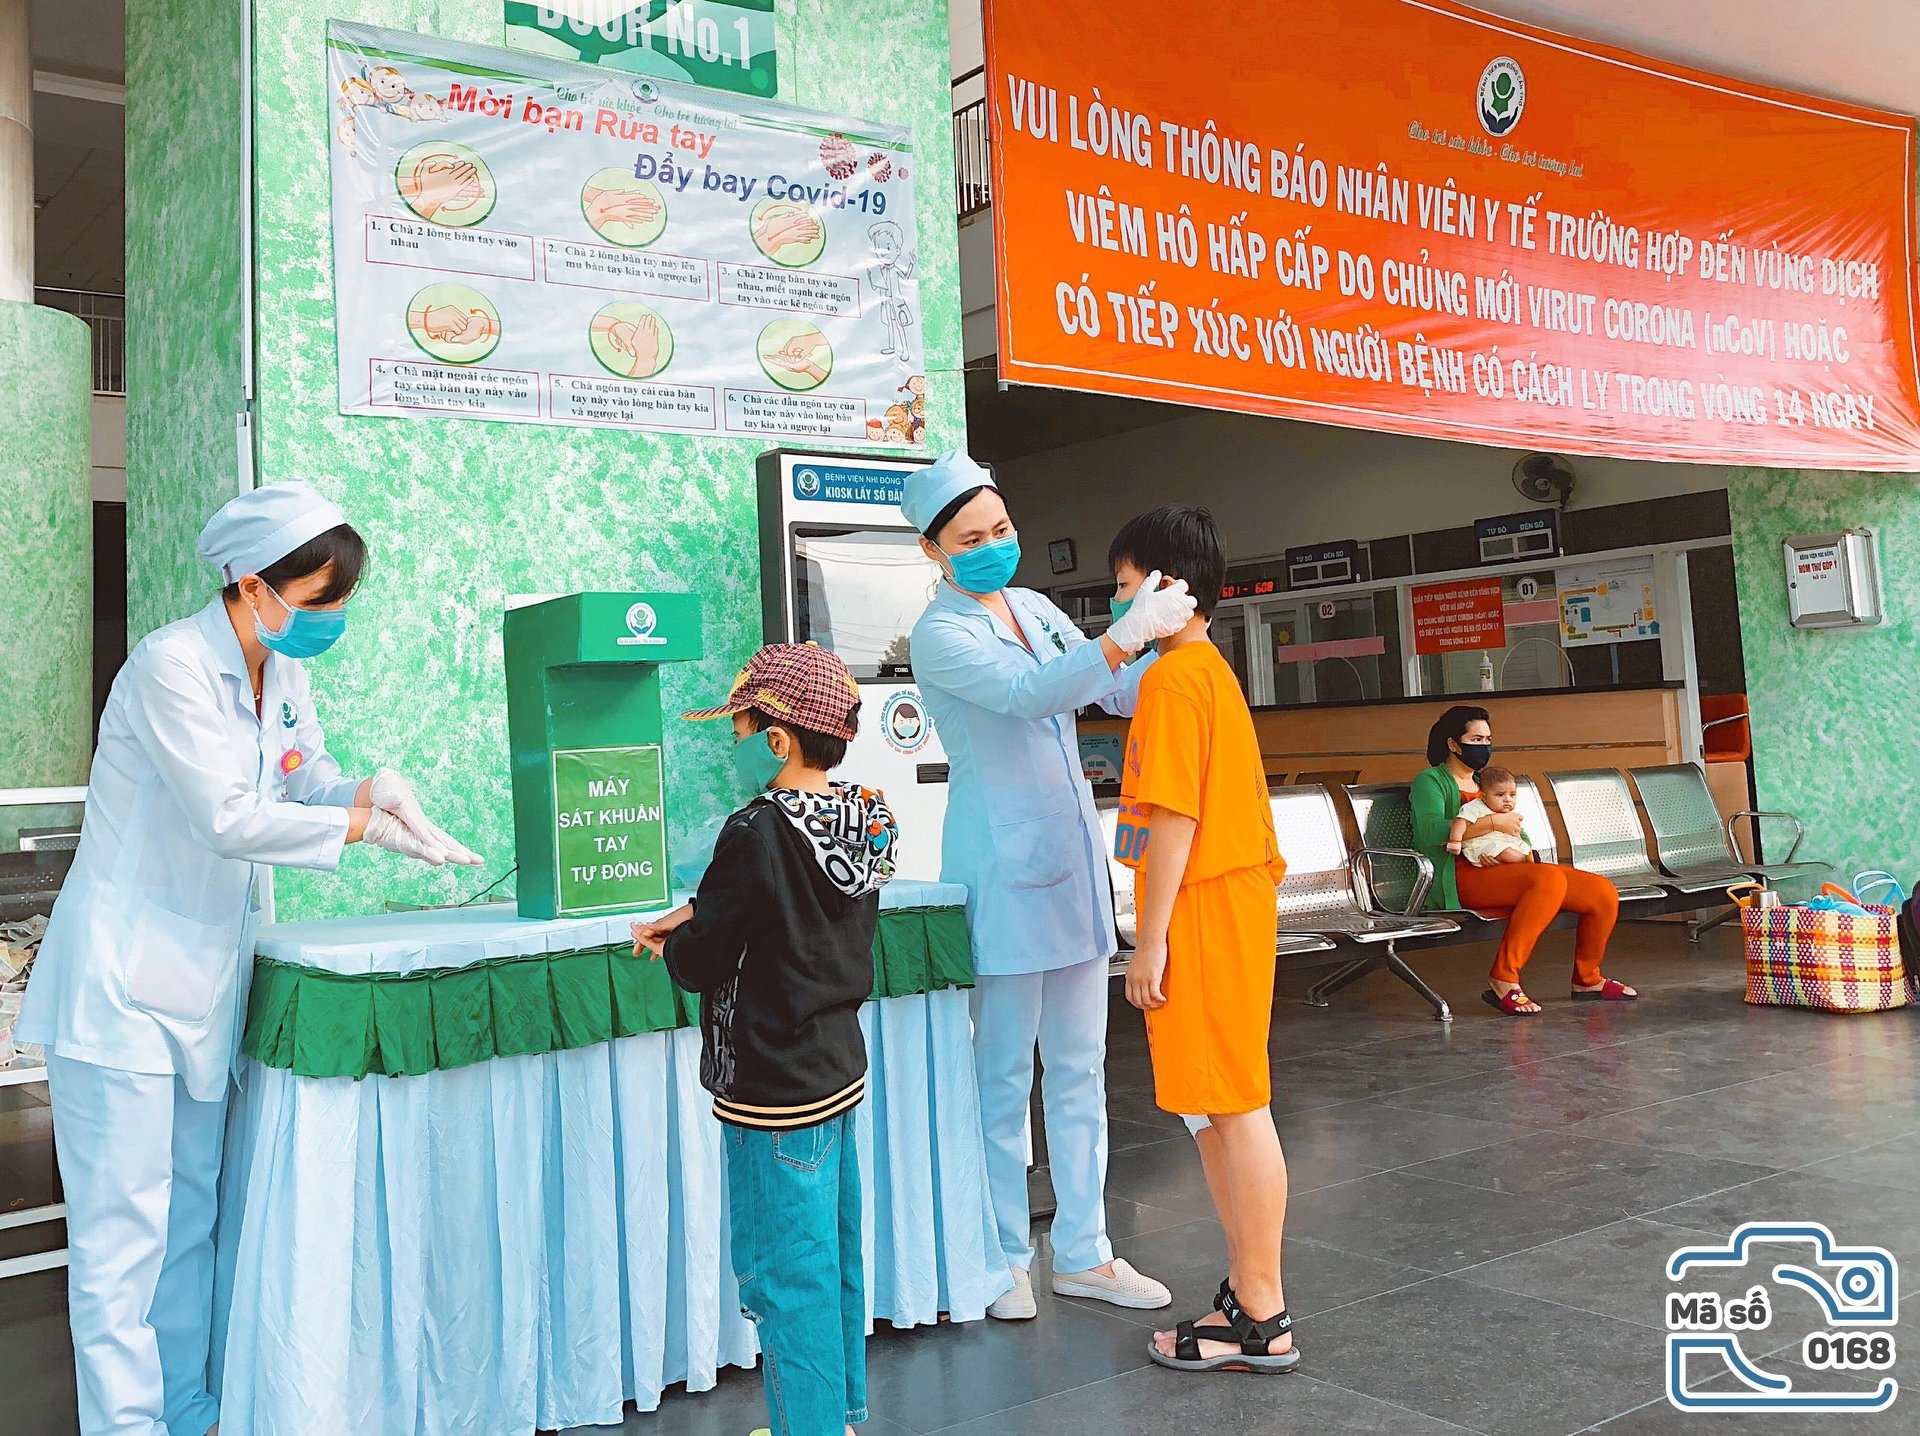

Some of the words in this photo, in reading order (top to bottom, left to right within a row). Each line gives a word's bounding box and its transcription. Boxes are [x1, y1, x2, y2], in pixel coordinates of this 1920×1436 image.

[666, 0, 750, 70] No.1
[448, 84, 512, 119] Mời
[522, 97, 583, 133] bạn
[595, 108, 658, 145] Rửa
[670, 123, 717, 161] tay
[634, 151, 694, 193] Đẩy
[702, 165, 756, 202] bay
[767, 174, 887, 215] Covid-19
[1008, 73, 1058, 142] VUI
[1070, 86, 1152, 169] LÒNG
[1160, 120, 1261, 194] THÔNG
[1270, 142, 1328, 208] BÁO
[1337, 162, 1409, 226] NHÂN
[1418, 178, 1476, 239] VIÊN
[1484, 198, 1500, 242] Y
[1508, 192, 1544, 250] TẾ
[1546, 209, 1638, 269] TRƯỜNG
[1646, 230, 1693, 282] HỢP
[1700, 230, 1746, 284] ĐẾN
[1753, 241, 1814, 294] VÙNG
[1822, 258, 1879, 306] DỊCH
[371, 221, 380, 231] 1.
[390, 222, 413, 235] Chà
[417, 227, 423, 236] 2
[427, 228, 450, 240] lòng
[455, 231, 474, 242] bàn
[478, 236, 494, 246] tay
[498, 238, 517, 248] vào
[391, 238, 419, 249] nhau
[549, 244, 557, 253] 2.
[590, 249, 595, 257] 2
[607, 266, 622, 275] tay
[626, 267, 640, 276] kia
[722, 268, 730, 276] 3.
[759, 271, 763, 279] 2
[766, 272, 785, 283] lòng
[823, 279, 837, 288] vào
[1066, 184, 1148, 257] VIÊM
[1156, 204, 1198, 267] HÔ
[1207, 211, 1266, 279] HẤP
[1275, 226, 1329, 291] CẤP
[1338, 250, 1374, 300] DO
[1382, 249, 1468, 317] CHỦNG
[1475, 269, 1520, 324] MỚI
[1528, 286, 1596, 335] VIRUT
[1604, 298, 1696, 348] CORONA
[1704, 312, 1774, 361] (nCoV)
[1784, 318, 1850, 372] HOẶC
[738, 282, 763, 292] nhau,
[815, 291, 828, 299] các
[831, 292, 850, 302] ngón
[738, 295, 751, 303] tay
[826, 304, 838, 313] tay
[1056, 273, 1100, 338] CÓ
[1107, 281, 1178, 348] TIẾP
[1187, 298, 1250, 361] XÚC
[1256, 309, 1307, 369] VỚI
[1310, 324, 1392, 382] NGƯỜI
[1397, 332, 1467, 398] BỆNH
[1472, 345, 1504, 399] CÓ
[1512, 351, 1573, 407] CÁCH
[1581, 369, 1608, 410] LY
[1616, 373, 1695, 420] TRONG
[1701, 374, 1768, 426] VÒNG
[1774, 389, 1804, 426] 14
[1811, 383, 1874, 430] NGÀY
[376, 366, 385, 374] 4.
[422, 369, 443, 380] mặt
[447, 371, 477, 381] ngoài
[395, 381, 412, 391] tay
[440, 383, 460, 393] bàn
[465, 386, 481, 396] tay
[485, 387, 504, 397] này
[508, 389, 527, 398] vào
[624, 386, 638, 395] tay
[642, 387, 655, 396] cái
[658, 388, 674, 398] của
[678, 389, 695, 398] bàn
[572, 396, 587, 405] tay
[612, 397, 629, 407] vào
[633, 399, 653, 409] lòng
[656, 401, 673, 409] bàn
[677, 404, 692, 413] tay
[695, 403, 708, 412] kia
[729, 394, 736, 402] 6.
[743, 395, 761, 404] Chà
[765, 397, 778, 405] các
[781, 397, 797, 406] đầu
[824, 402, 837, 410] tay
[840, 403, 854, 411] của
[572, 408, 583, 416] và
[621, 411, 633, 421] lại
[744, 407, 760, 416] bàn
[763, 409, 776, 418] tay
[780, 410, 795, 420] này
[744, 420, 758, 428] tay
[761, 420, 775, 429] kia
[820, 424, 831, 432] lại
[825, 473, 845, 482] BỆNH
[848, 475, 863, 483] VIỆN
[826, 487, 852, 499] KIOSK
[855, 485, 871, 500] LẤY
[874, 486, 885, 500] SỐ
[1255, 581, 1273, 594] 608
[1522, 583, 1533, 595] 01
[1322, 604, 1332, 616] 02
[588, 775, 630, 798] MÁY
[559, 808, 594, 828] SÁT
[600, 804, 660, 825] KHUẨN
[594, 835, 628, 852] TAY
[571, 865, 597, 885] TỰ
[601, 860, 652, 882] ĐỘNG
